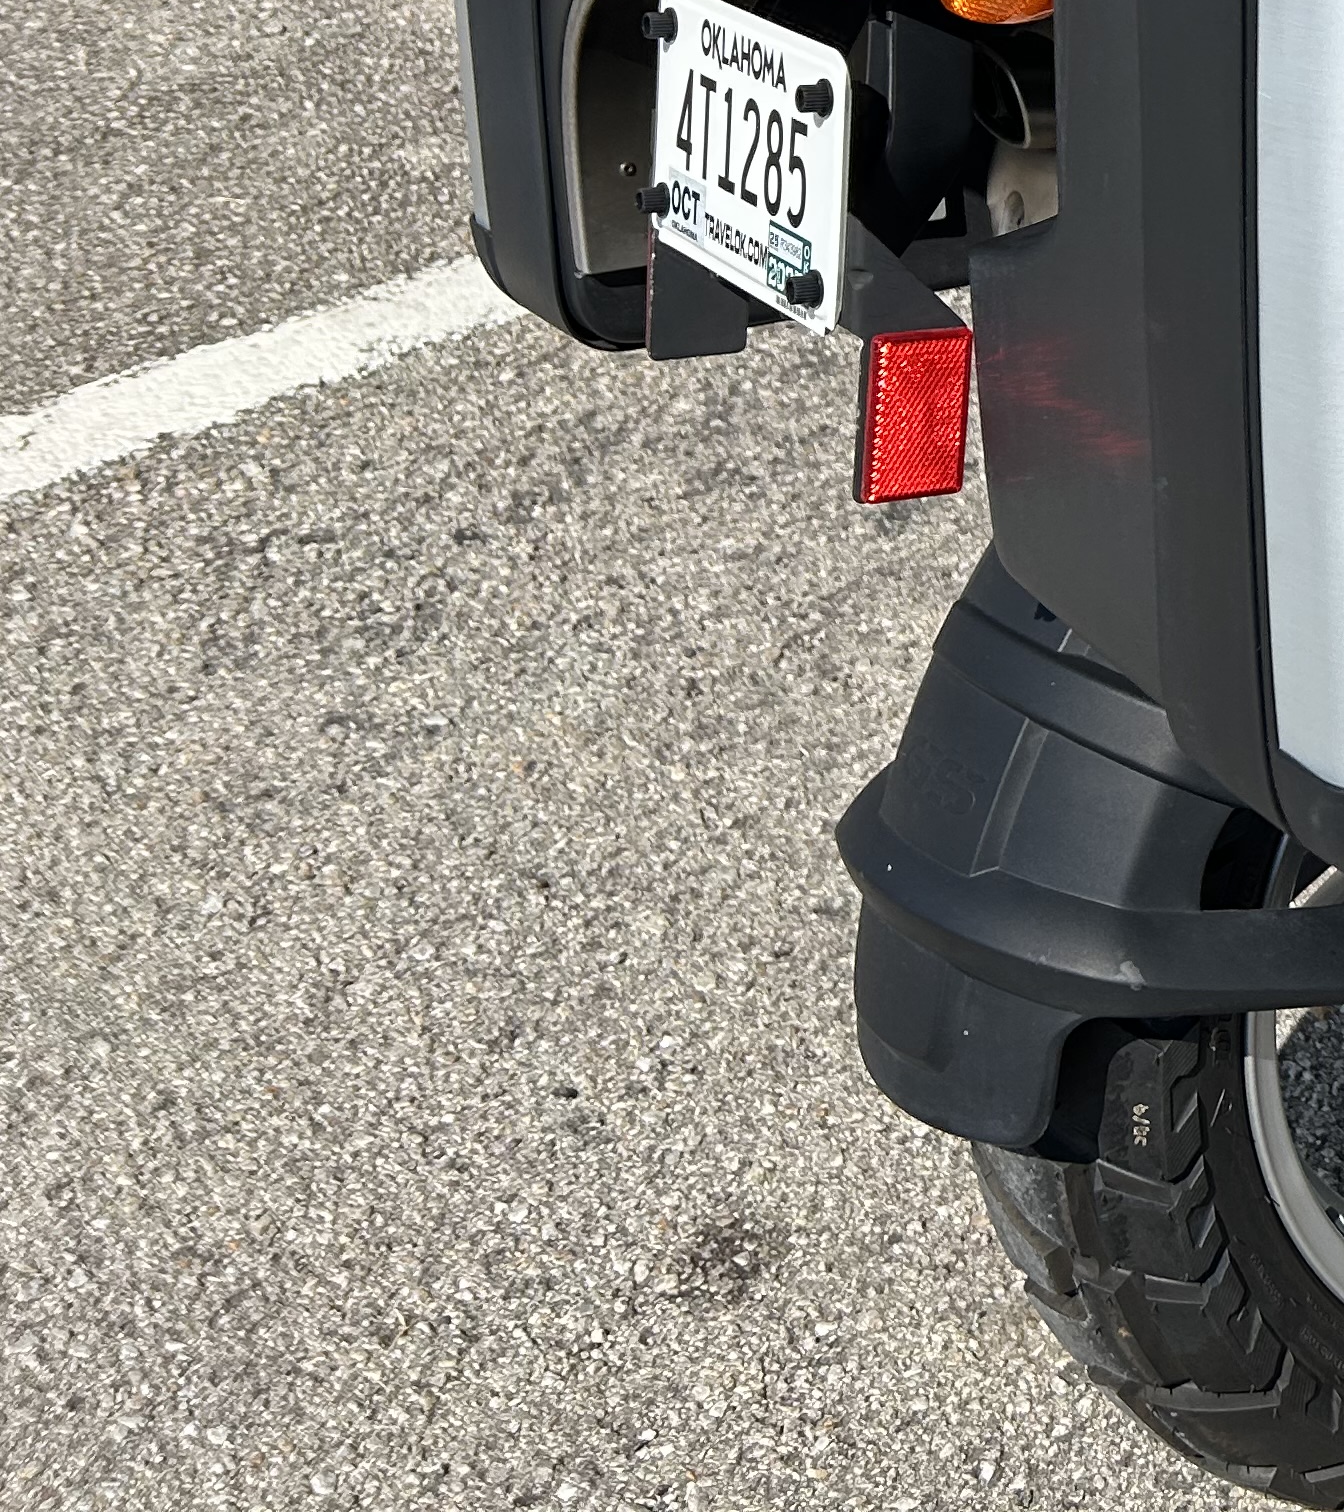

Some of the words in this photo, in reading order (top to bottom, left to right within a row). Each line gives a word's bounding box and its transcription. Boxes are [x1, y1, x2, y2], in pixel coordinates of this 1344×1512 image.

[700, 18, 787, 93] OKLAHOMA
[675, 68, 809, 229] 4T1285
[671, 179, 702, 227] OCT
[704, 211, 768, 271] TRAVELOK.COM
